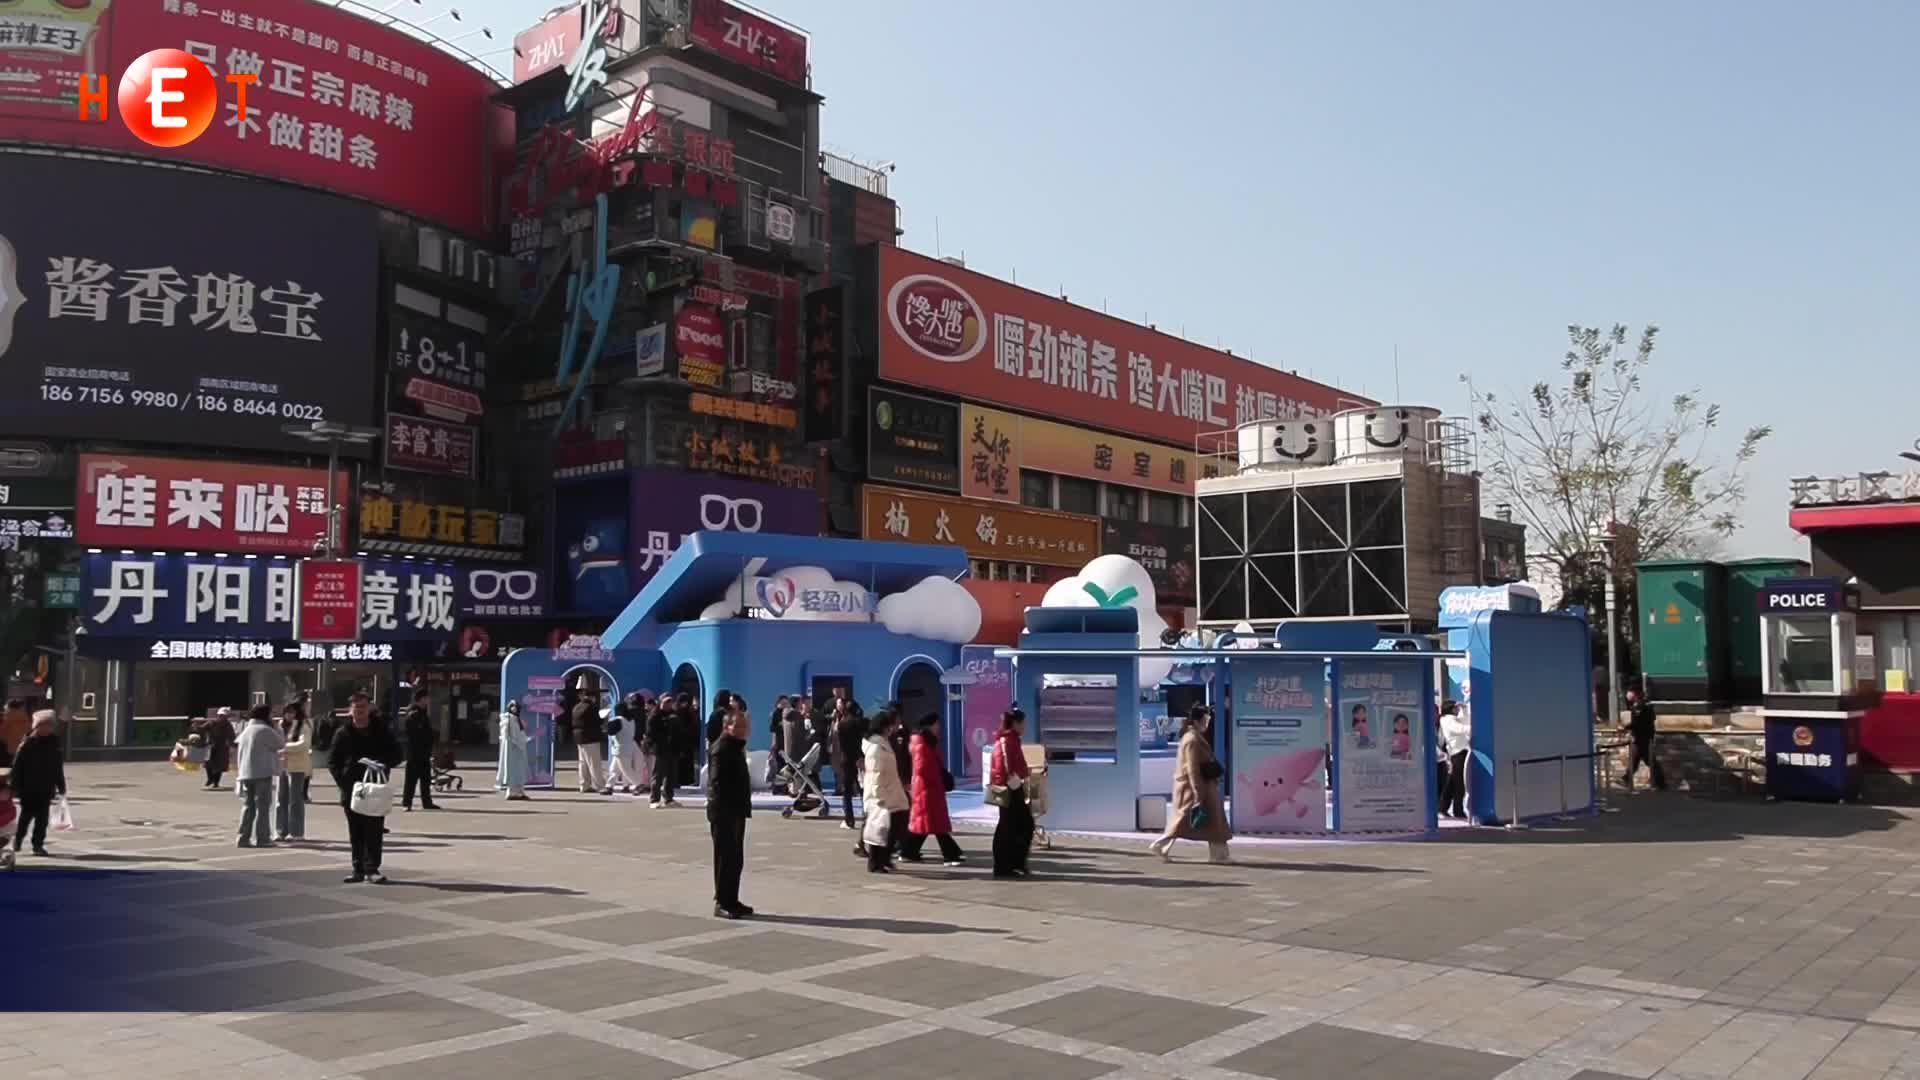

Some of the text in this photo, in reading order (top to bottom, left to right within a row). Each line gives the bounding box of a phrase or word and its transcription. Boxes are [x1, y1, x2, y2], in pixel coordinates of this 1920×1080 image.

[45, 255, 324, 342] 酱香瑰宝
[994, 312, 1118, 400] 嚼劲辣条
[1127, 351, 1228, 427] 馋大嘴巴
[40, 384, 323, 420] 186 7156 9980 / 186 8464 0022
[95, 473, 290, 533] 蛙来哒
[1769, 593, 1826, 608] POLICE
[150, 640, 274, 659] 全国眼镜集散地
